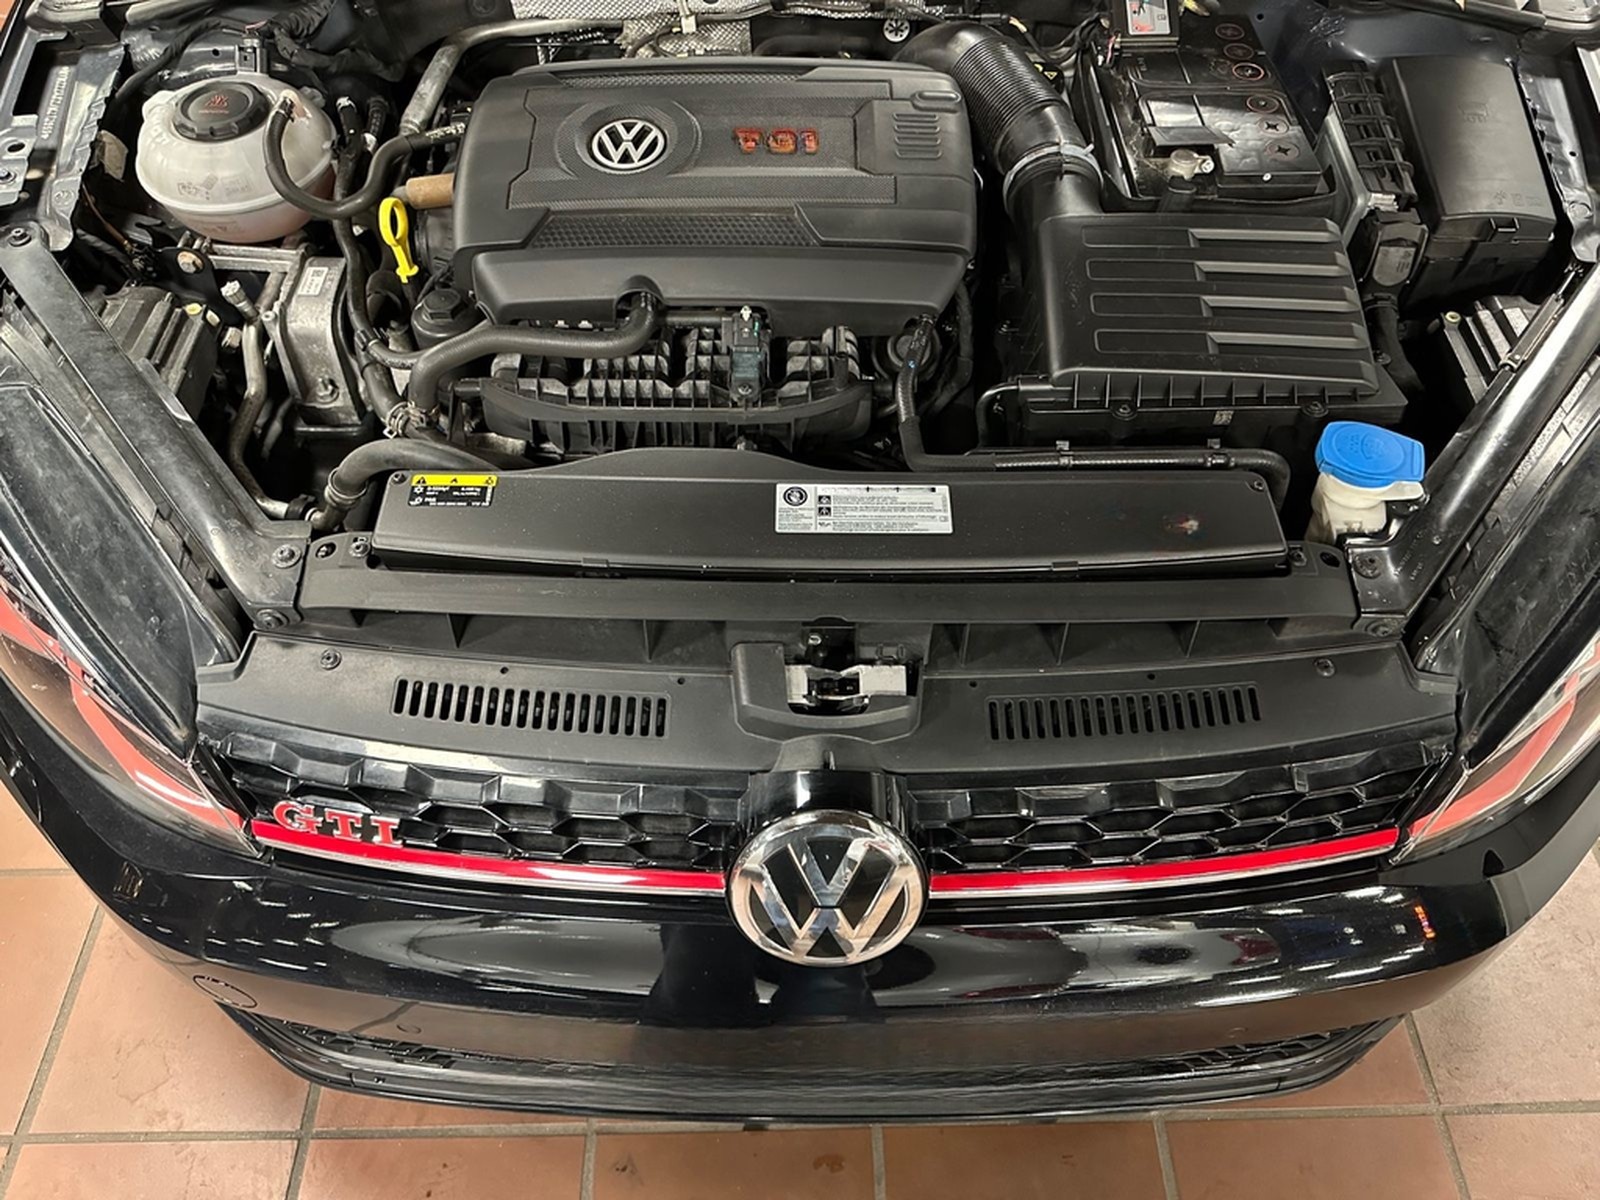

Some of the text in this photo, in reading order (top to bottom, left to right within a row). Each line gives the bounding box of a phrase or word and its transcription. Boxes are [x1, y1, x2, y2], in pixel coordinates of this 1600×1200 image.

[592, 119, 665, 169] VW
[273, 800, 403, 848] GTI
[730, 809, 926, 967] VW
